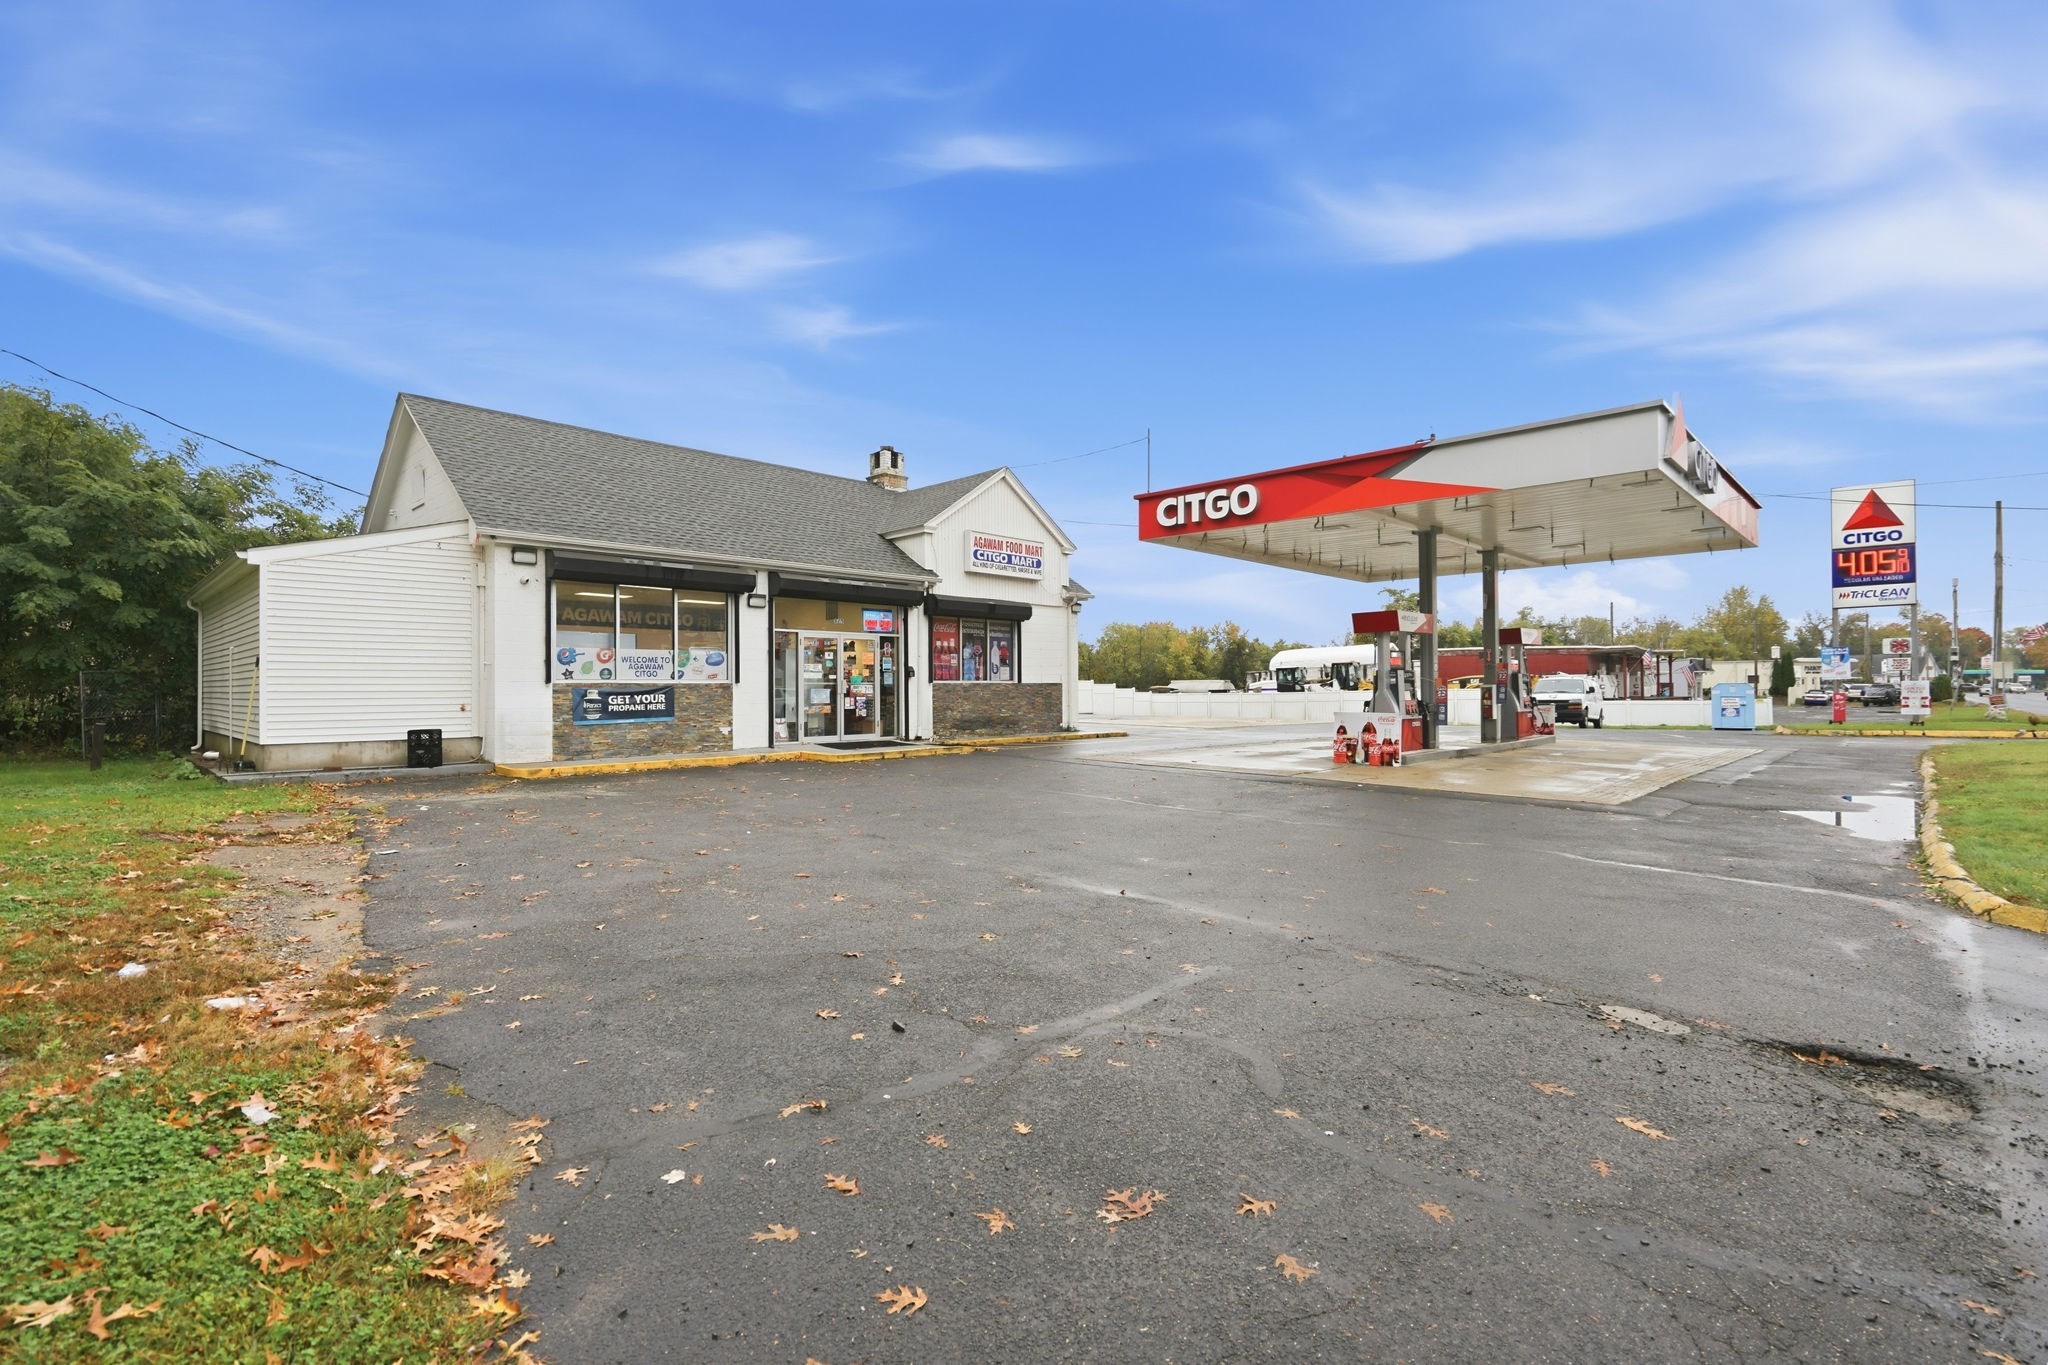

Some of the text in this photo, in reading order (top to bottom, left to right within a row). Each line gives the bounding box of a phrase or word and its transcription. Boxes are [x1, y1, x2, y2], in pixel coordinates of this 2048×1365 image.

[1156, 484, 1258, 527] CITGO
[1843, 530, 1903, 545] CITGO
[973, 536, 1043, 557] AGAWAM FOOD MART
[977, 550, 1038, 568] CITGO MART
[1838, 550, 1897, 576] 4.05
[645, 611, 694, 627] CITO
[621, 656, 658, 664] WELCOME
[634, 670, 658, 678] CITGO
[608, 693, 666, 705] GET YOUR
[608, 702, 666, 712] PROPANE HERE
